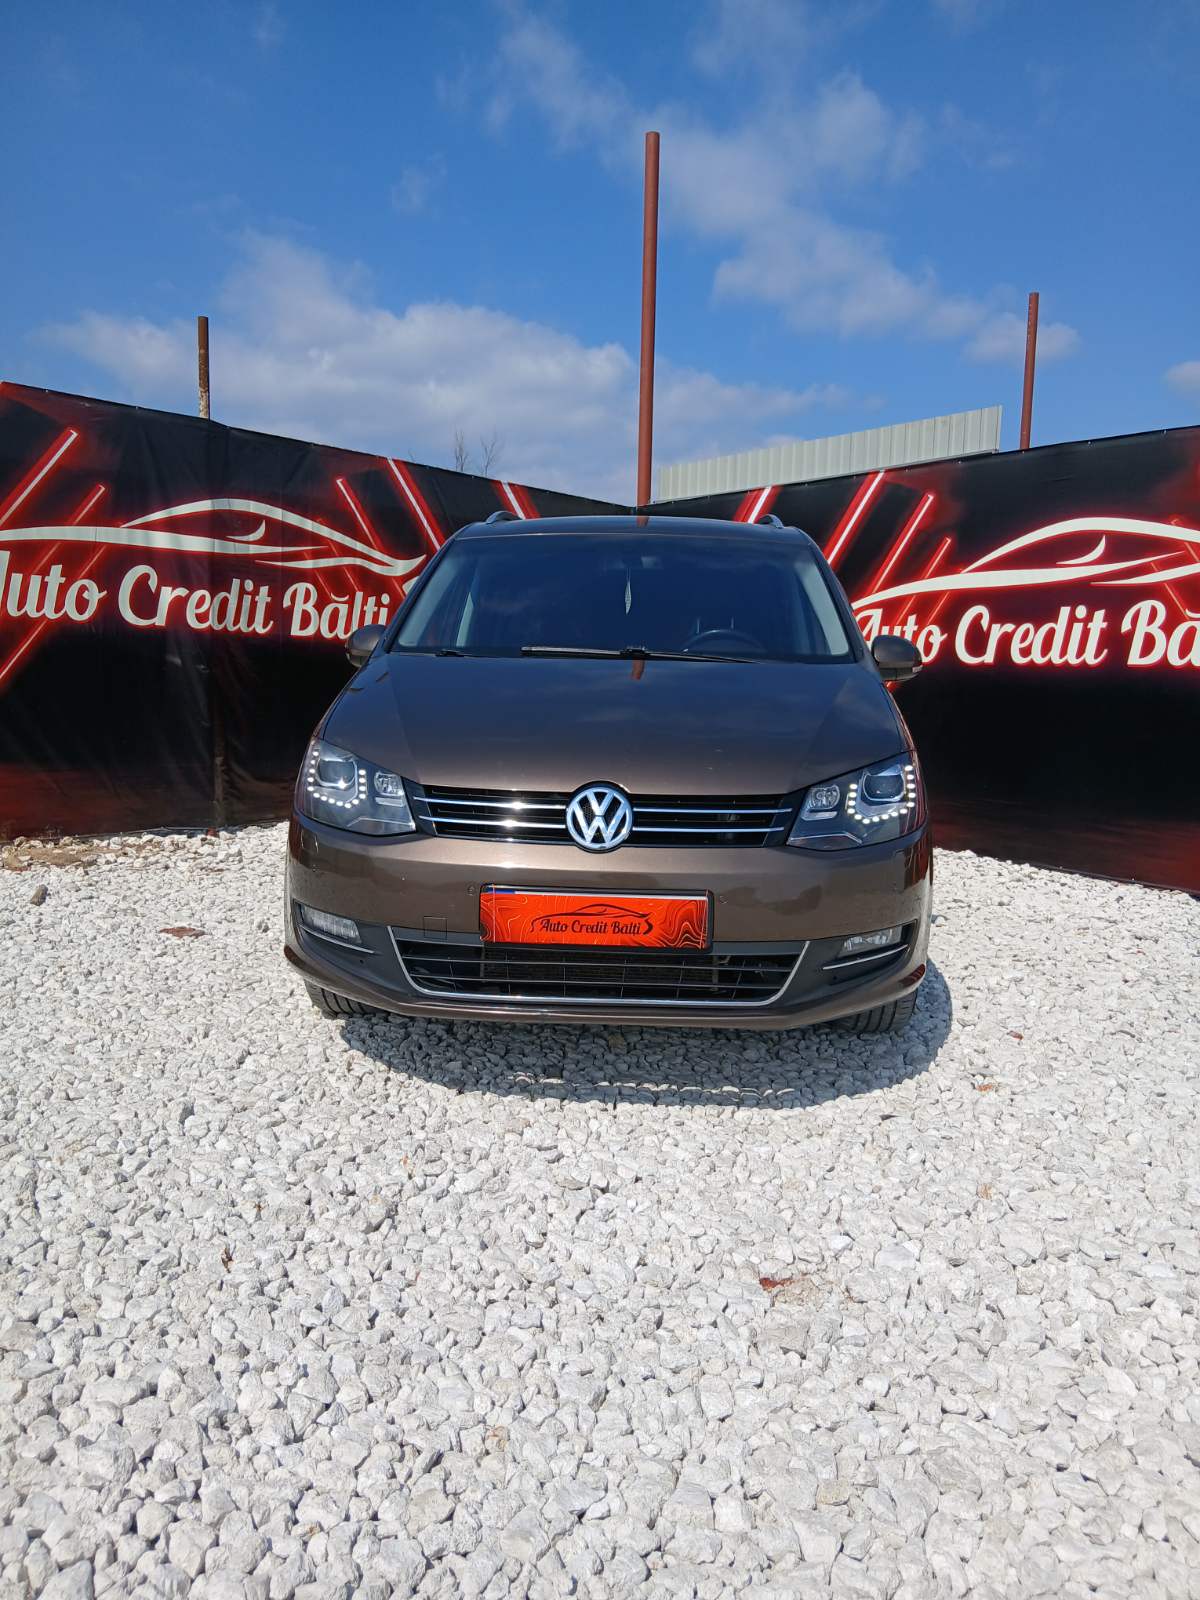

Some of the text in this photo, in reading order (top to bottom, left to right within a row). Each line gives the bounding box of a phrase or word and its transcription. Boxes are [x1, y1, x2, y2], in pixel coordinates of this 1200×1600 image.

[118, 565, 274, 634] Credit
[854, 608, 949, 663] Ato
[954, 605, 1108, 665] Credit
[570, 788, 630, 847] VW
[539, 919, 568, 933] Auto
[571, 919, 609, 934] Credit
